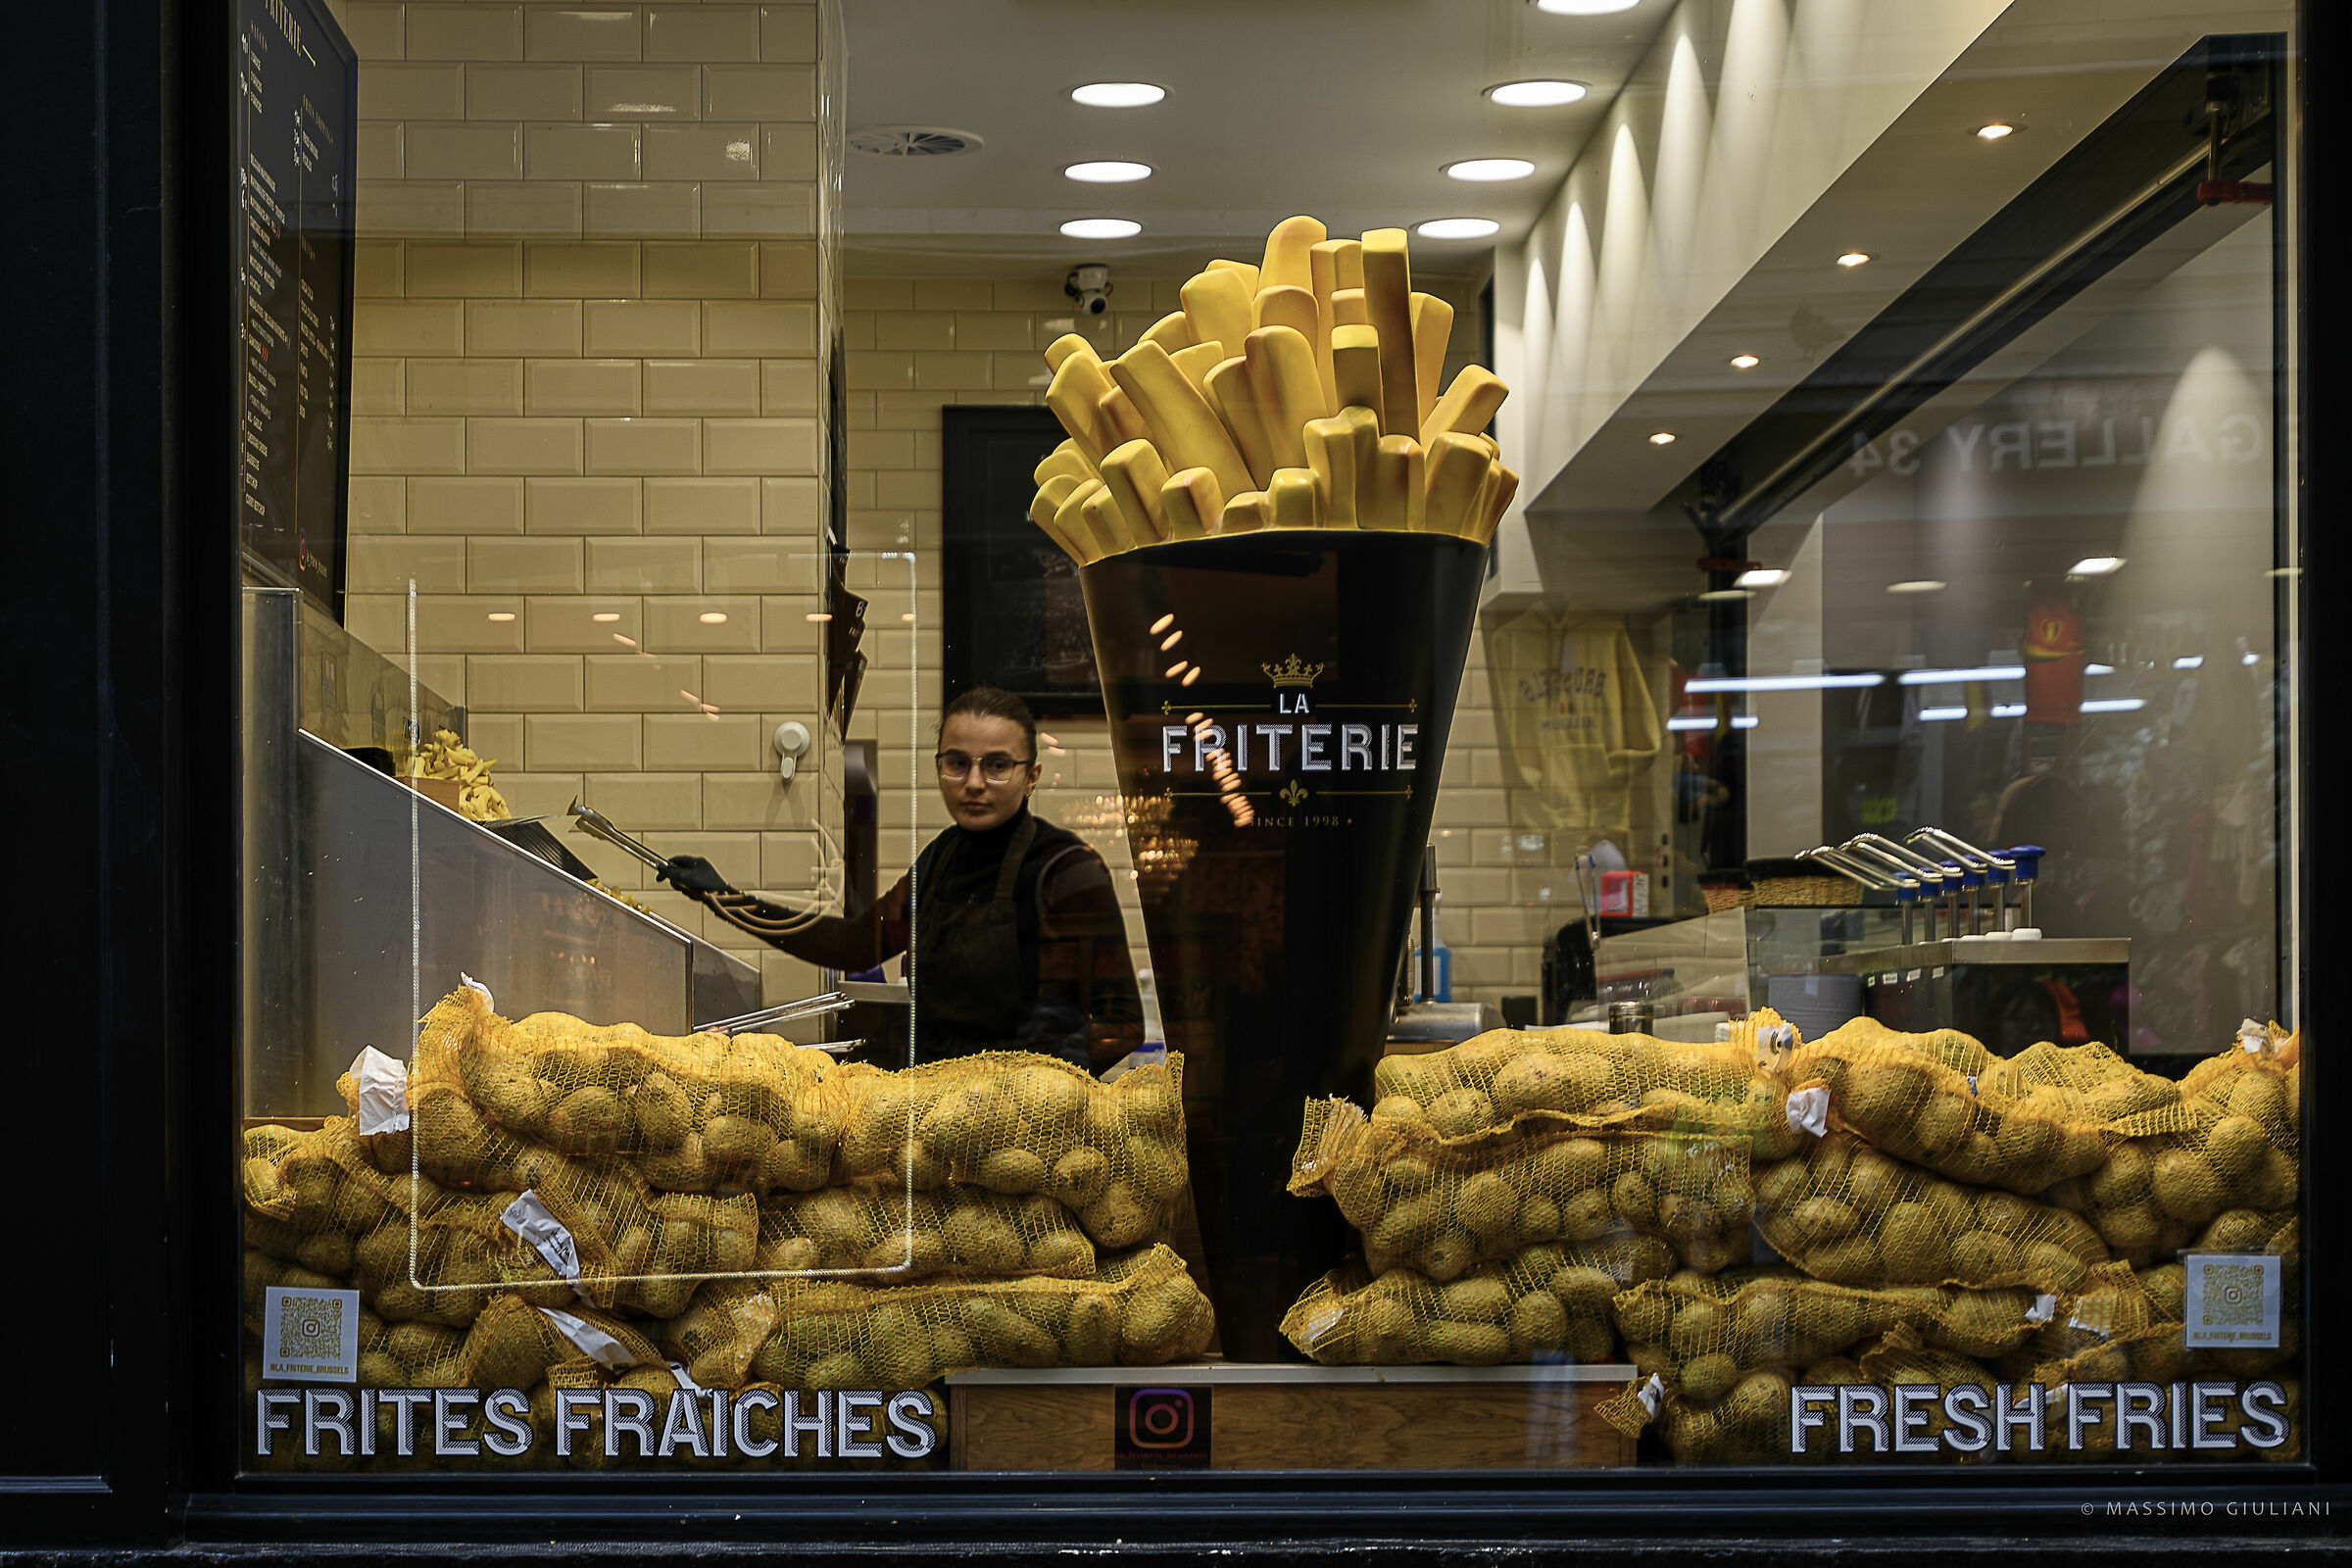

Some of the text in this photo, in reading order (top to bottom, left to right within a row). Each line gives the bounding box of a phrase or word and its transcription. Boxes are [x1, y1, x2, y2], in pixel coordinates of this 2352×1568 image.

[266, 0, 302, 57] RITERIE
[1279, 693, 1310, 714] LA
[1162, 723, 1419, 772] FRITERIE
[1304, 815, 1340, 827] 1998
[257, 1388, 938, 1458] FRITES FRAICHES
[1789, 1380, 2291, 1453] FRESH FRIES
